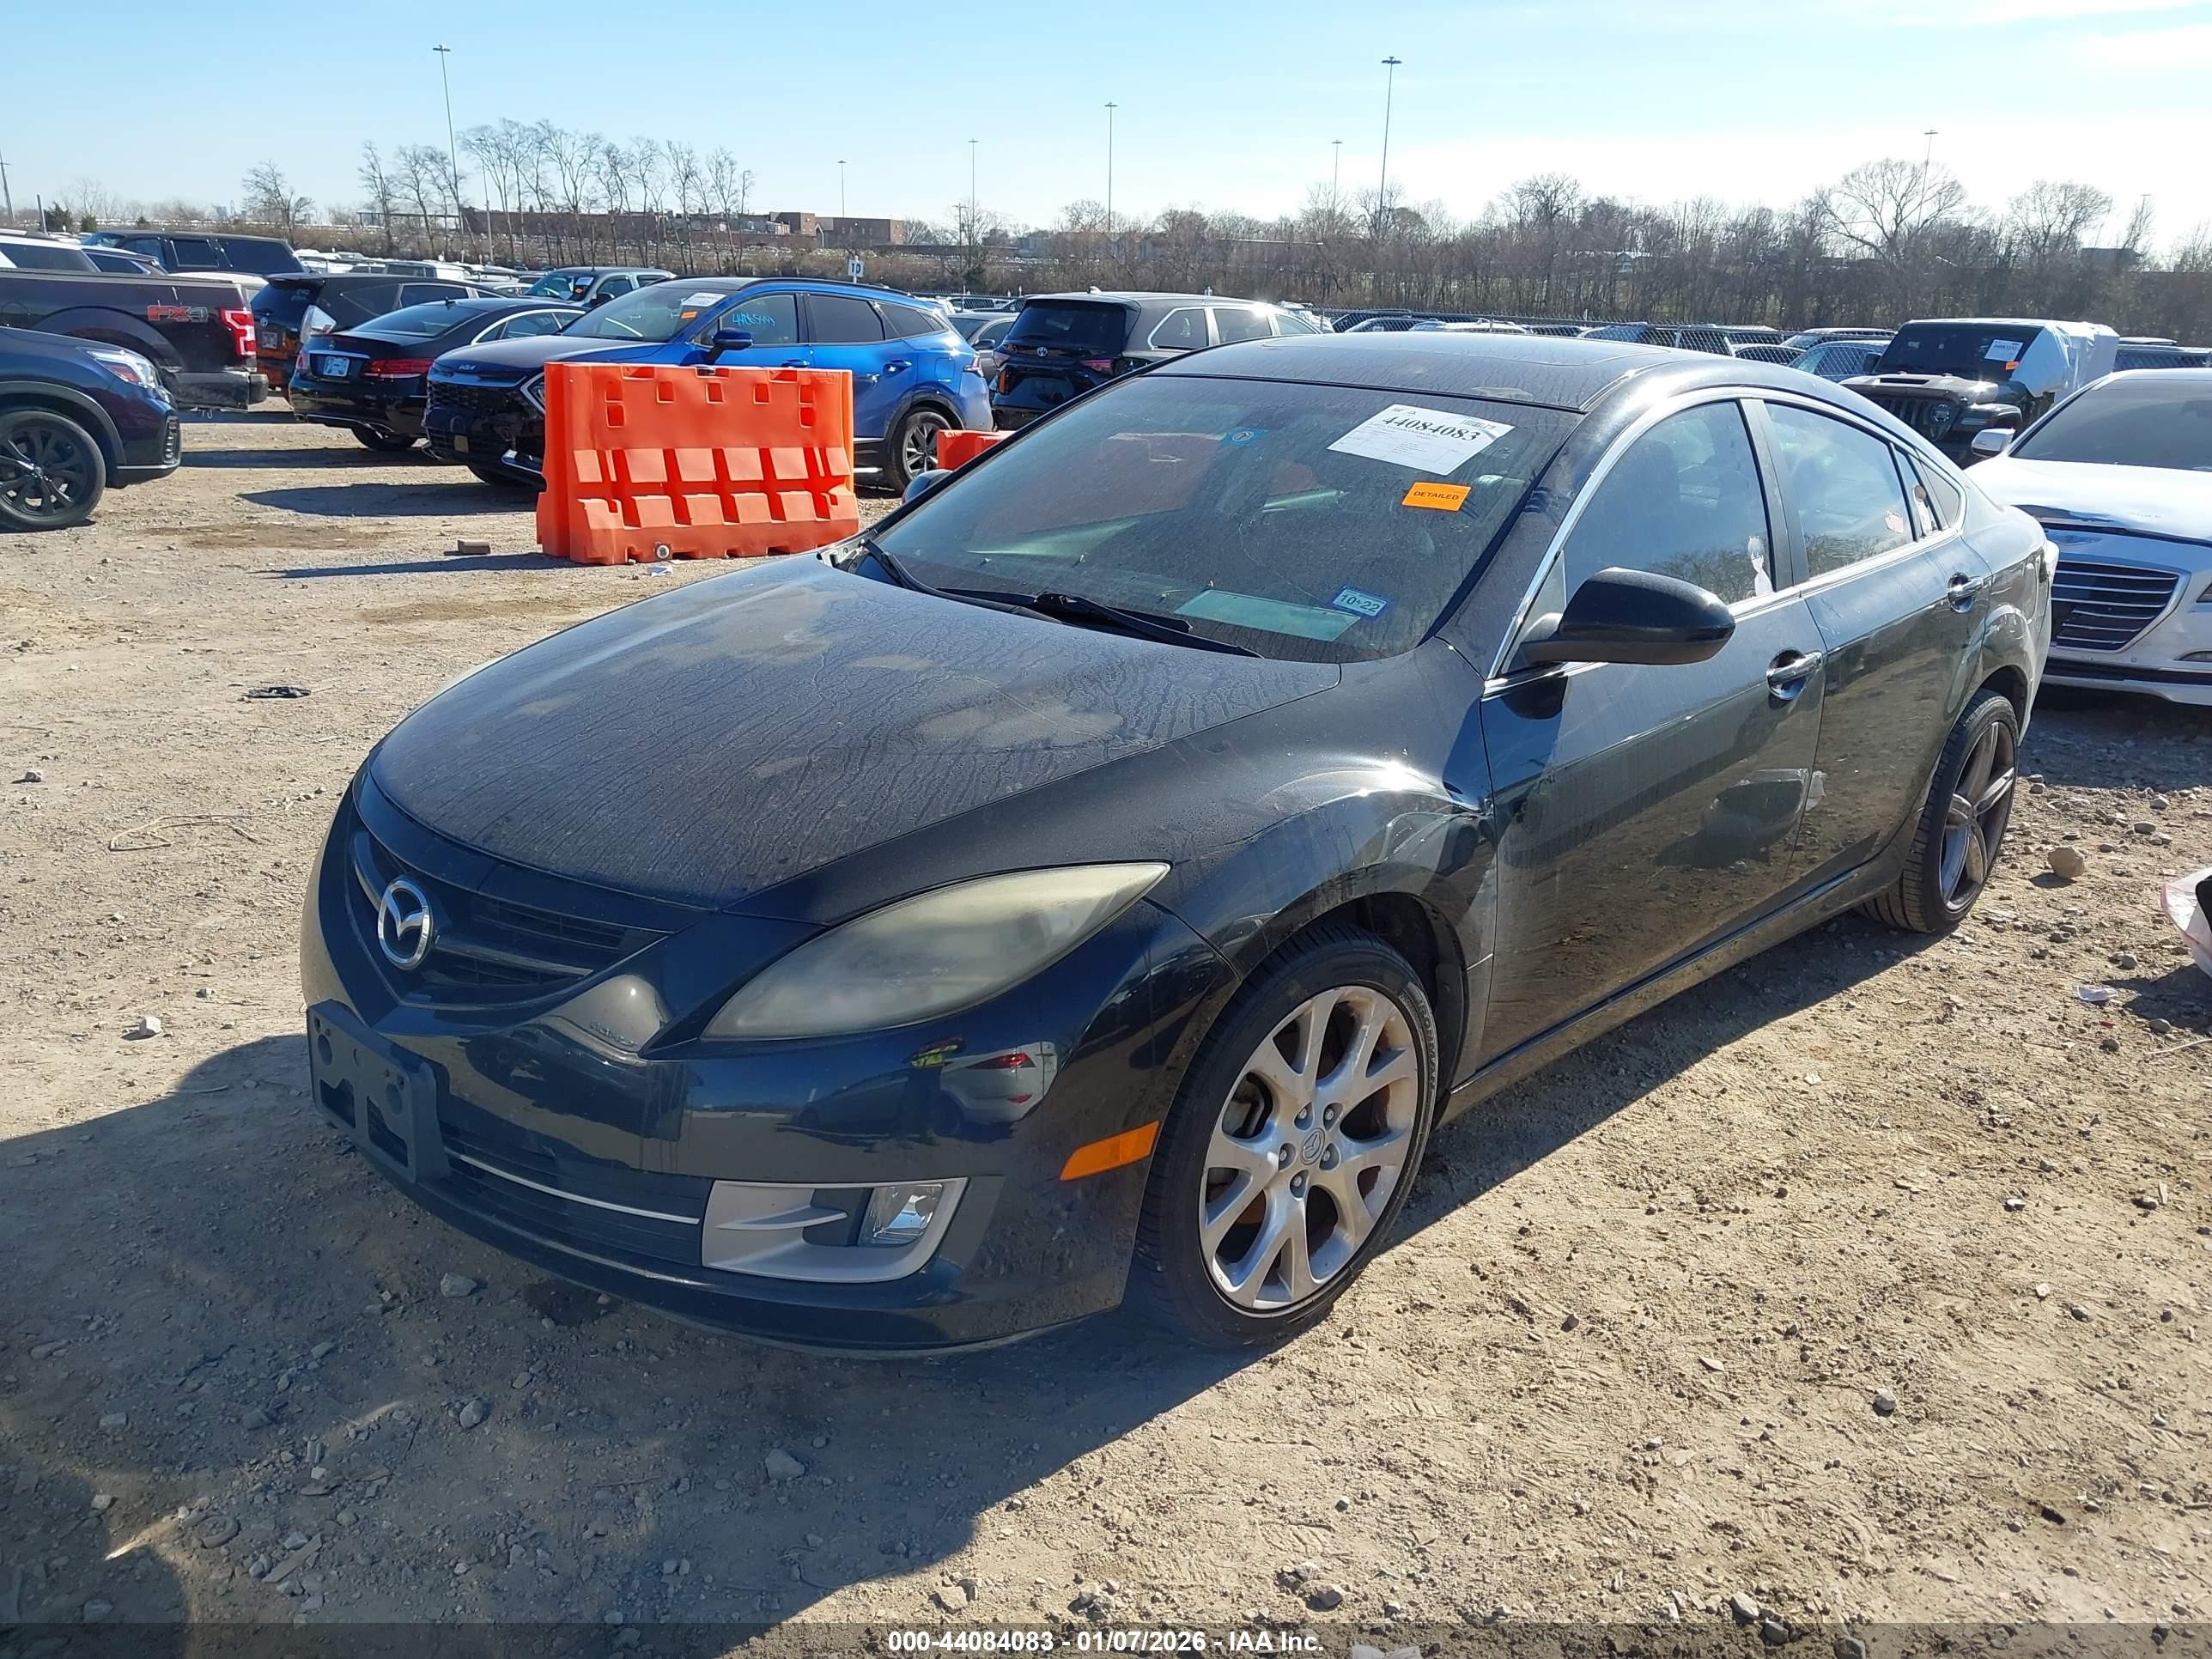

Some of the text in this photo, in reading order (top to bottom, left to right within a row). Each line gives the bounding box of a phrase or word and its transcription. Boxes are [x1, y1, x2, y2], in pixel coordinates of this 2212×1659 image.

[851, 263, 861, 274] 10
[147, 304, 209, 323] FX4
[1382, 416, 1481, 441] 44084083
[1413, 490, 1460, 501] DETAILED
